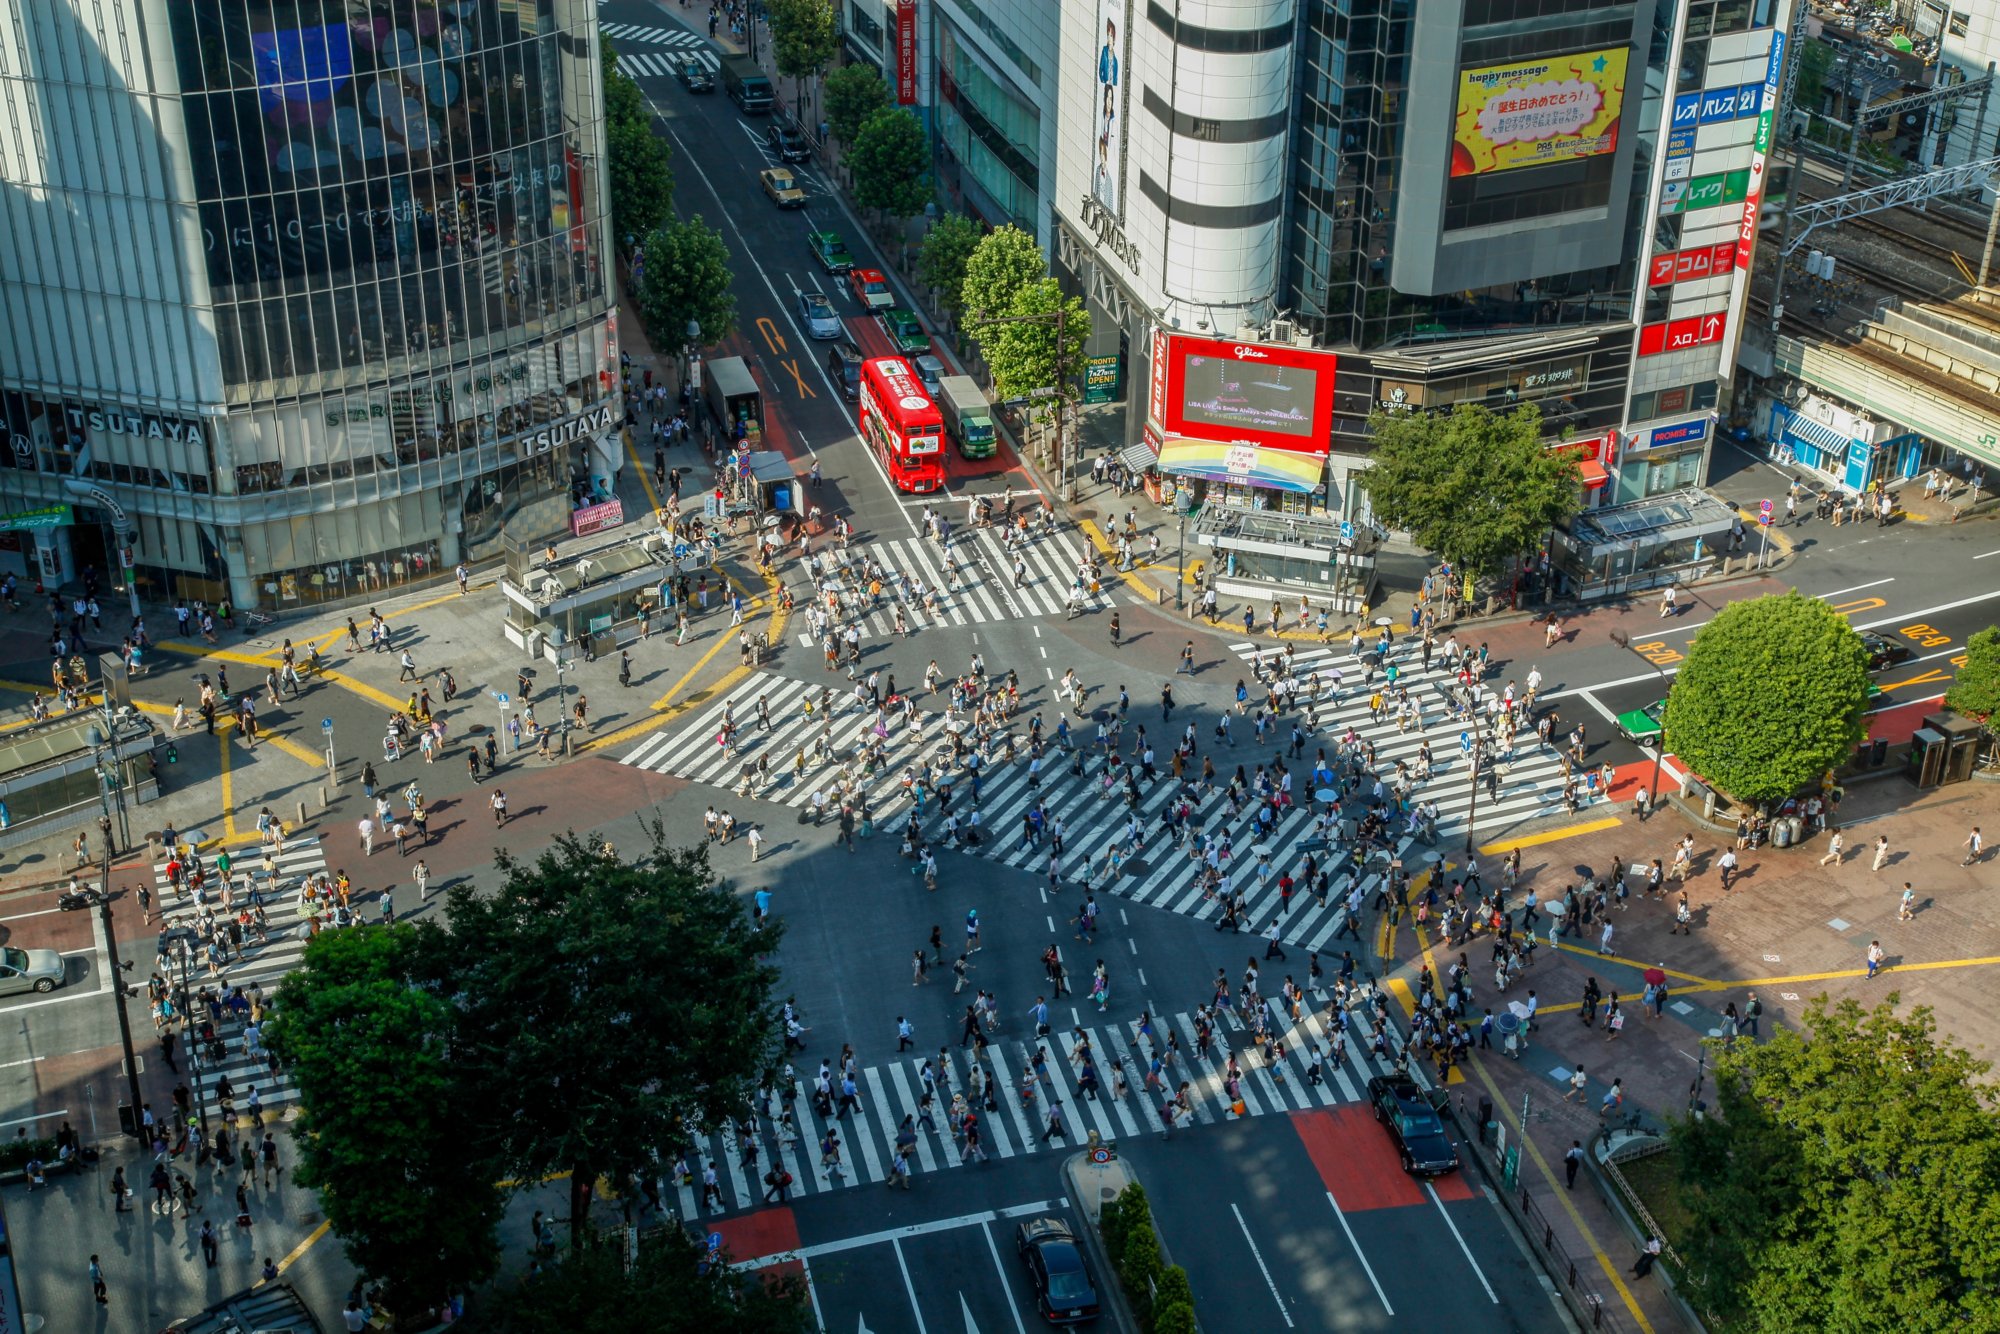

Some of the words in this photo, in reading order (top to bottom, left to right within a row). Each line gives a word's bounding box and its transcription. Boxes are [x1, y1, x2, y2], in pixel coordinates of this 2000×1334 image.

[902, 21, 912, 97] 三菱東京UFJ銀行
[1675, 90, 1757, 121] レオパレス21
[1758, 117, 1769, 144] レイク
[1671, 168, 1682, 177] 6F
[1688, 182, 1722, 200] レイク
[1742, 202, 1755, 240] アコム
[1656, 254, 1709, 278] アコム
[1672, 333, 1692, 346] 入口
[1234, 346, 1268, 359] Glico
[1088, 375, 1116, 384] OPEN!!
[1525, 367, 1573, 388] 星乃珈琲
[69, 408, 202, 444] TSUTAYA
[522, 406, 613, 456] TSUTAYA
[1655, 428, 1687, 441] PROMISE
[1977, 434, 1996, 448] JR
[1900, 624, 1952, 648] 8-20
[1634, 641, 1684, 665] 8-20
